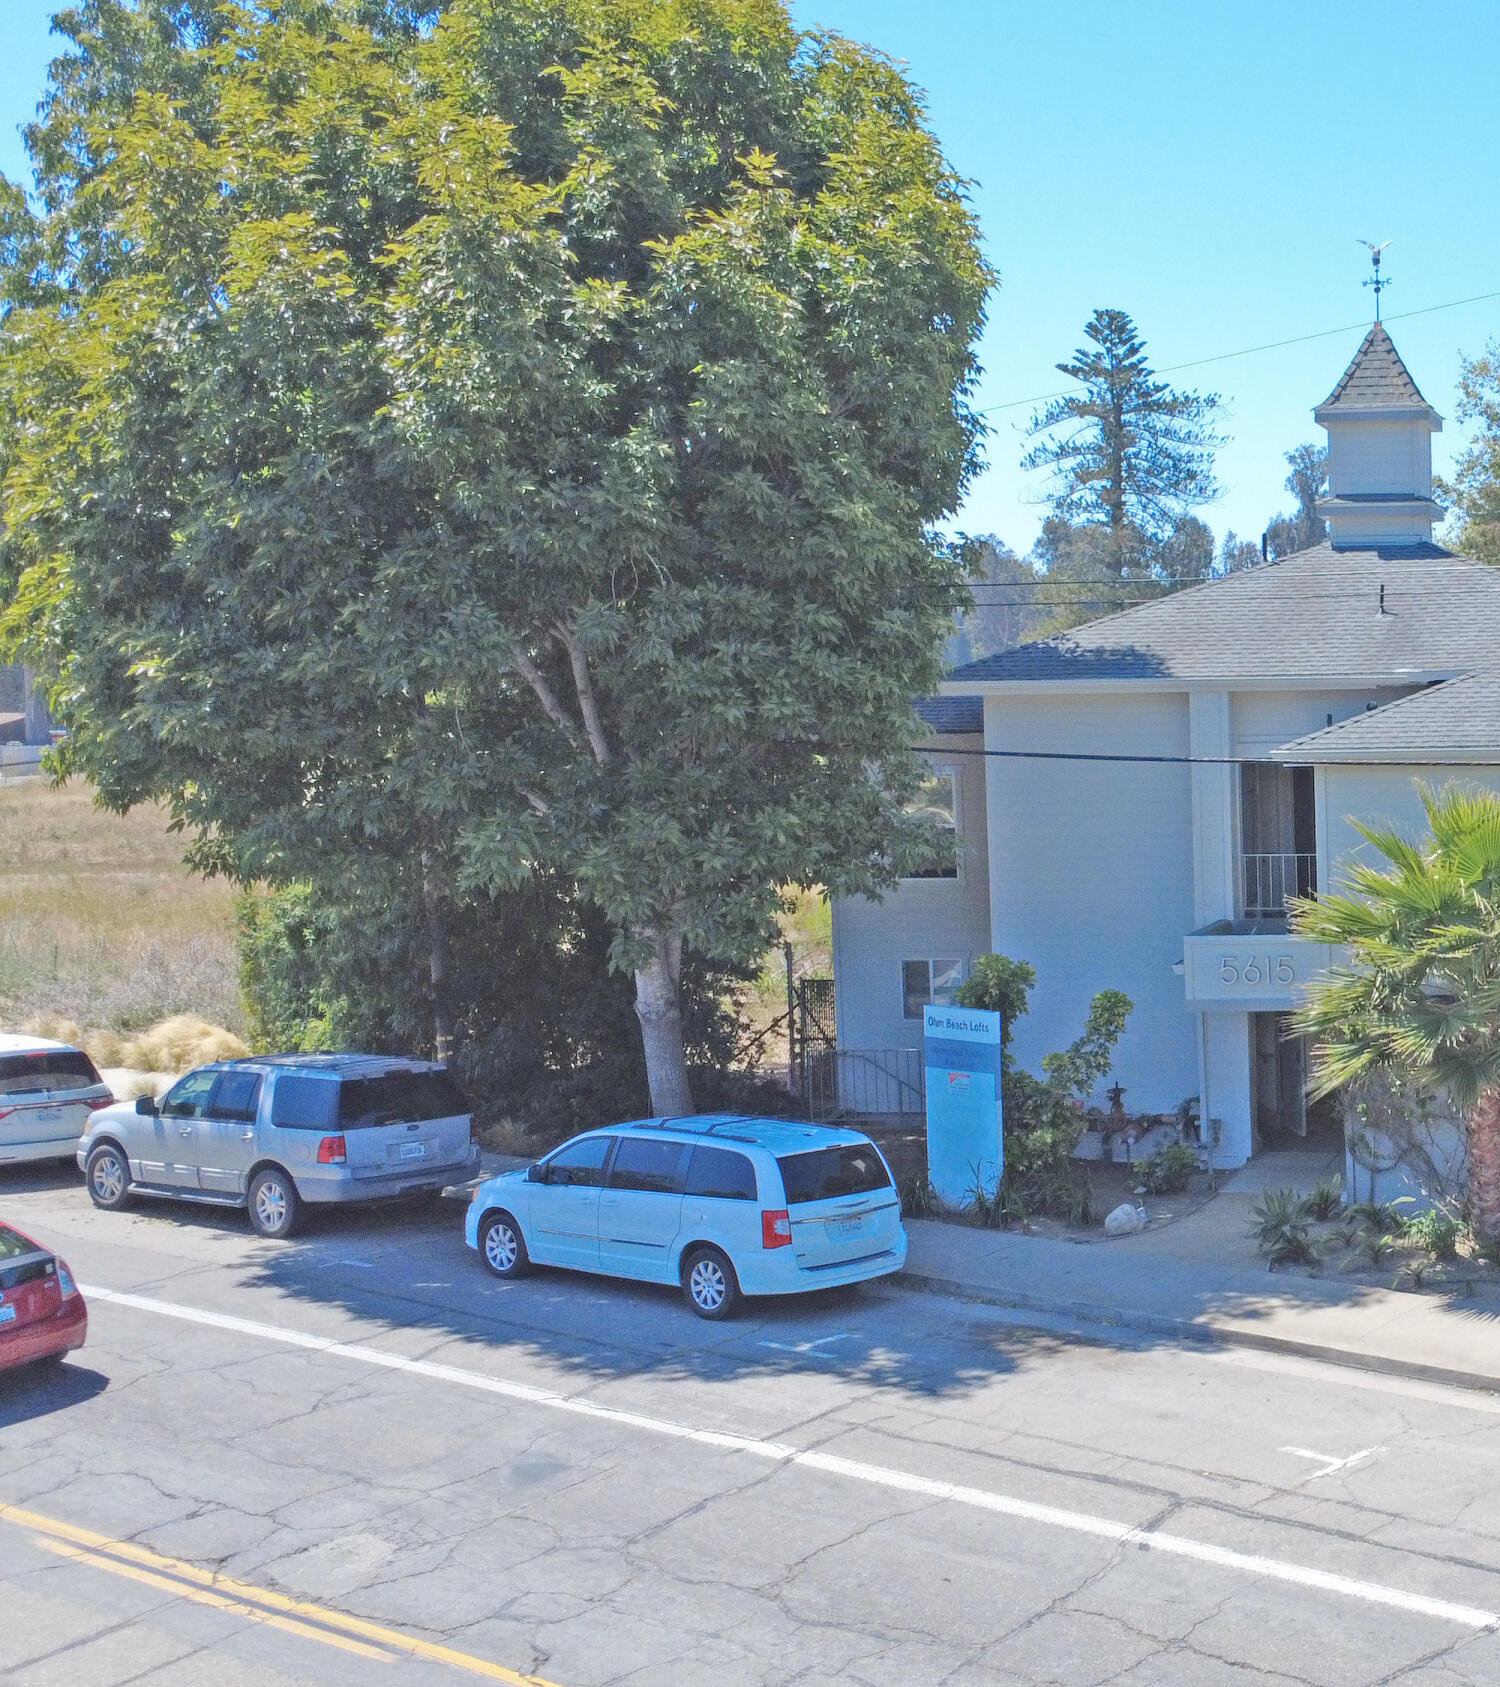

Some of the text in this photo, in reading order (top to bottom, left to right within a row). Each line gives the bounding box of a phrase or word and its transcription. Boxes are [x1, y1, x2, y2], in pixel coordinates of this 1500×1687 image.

[1220, 955, 1295, 985] 5615
[946, 1018, 968, 1031] Beach
[970, 1021, 989, 1033] Lofts
